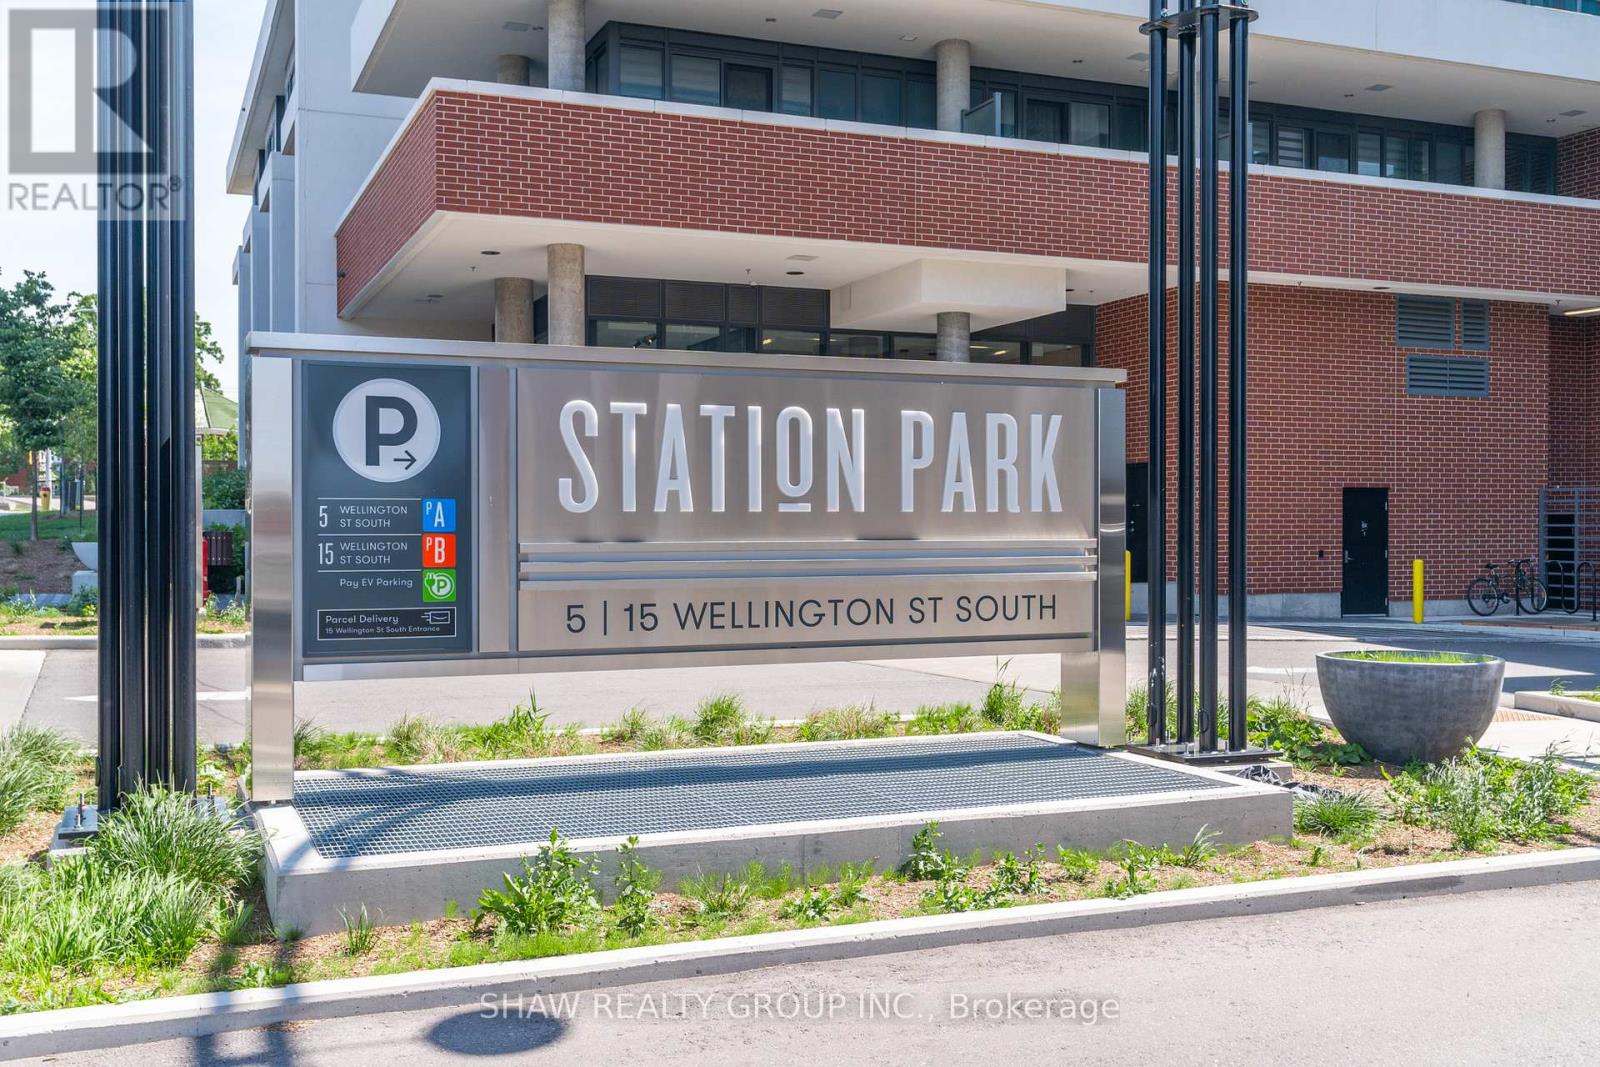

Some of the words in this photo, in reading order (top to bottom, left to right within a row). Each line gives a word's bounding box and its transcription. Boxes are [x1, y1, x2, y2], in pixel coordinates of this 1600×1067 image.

[365, 395, 418, 466] P
[558, 399, 865, 513] STATION
[900, 409, 1064, 513] PARK
[319, 505, 328, 528] 5
[340, 505, 408, 515] WELLINGTON
[340, 519, 352, 528] ST
[355, 519, 391, 528] SOUTH
[318, 542, 334, 565] 15
[340, 542, 408, 551] WELLINGTON
[340, 555, 352, 564] ST
[355, 555, 391, 564] SOUTH
[340, 578, 359, 589] Pay
[362, 578, 373, 587] EV
[376, 577, 413, 588] Parking
[325, 615, 356, 624] Parcel
[360, 614, 399, 625] Delivery
[566, 604, 586, 634] 5
[624, 603, 658, 632] 15
[673, 596, 894, 630] WELLINGTON
[909, 597, 943, 624] ST
[956, 594, 1056, 622] SOUTH
[335, 627, 374, 635] Wellington
[408, 625, 440, 633] Entrance
